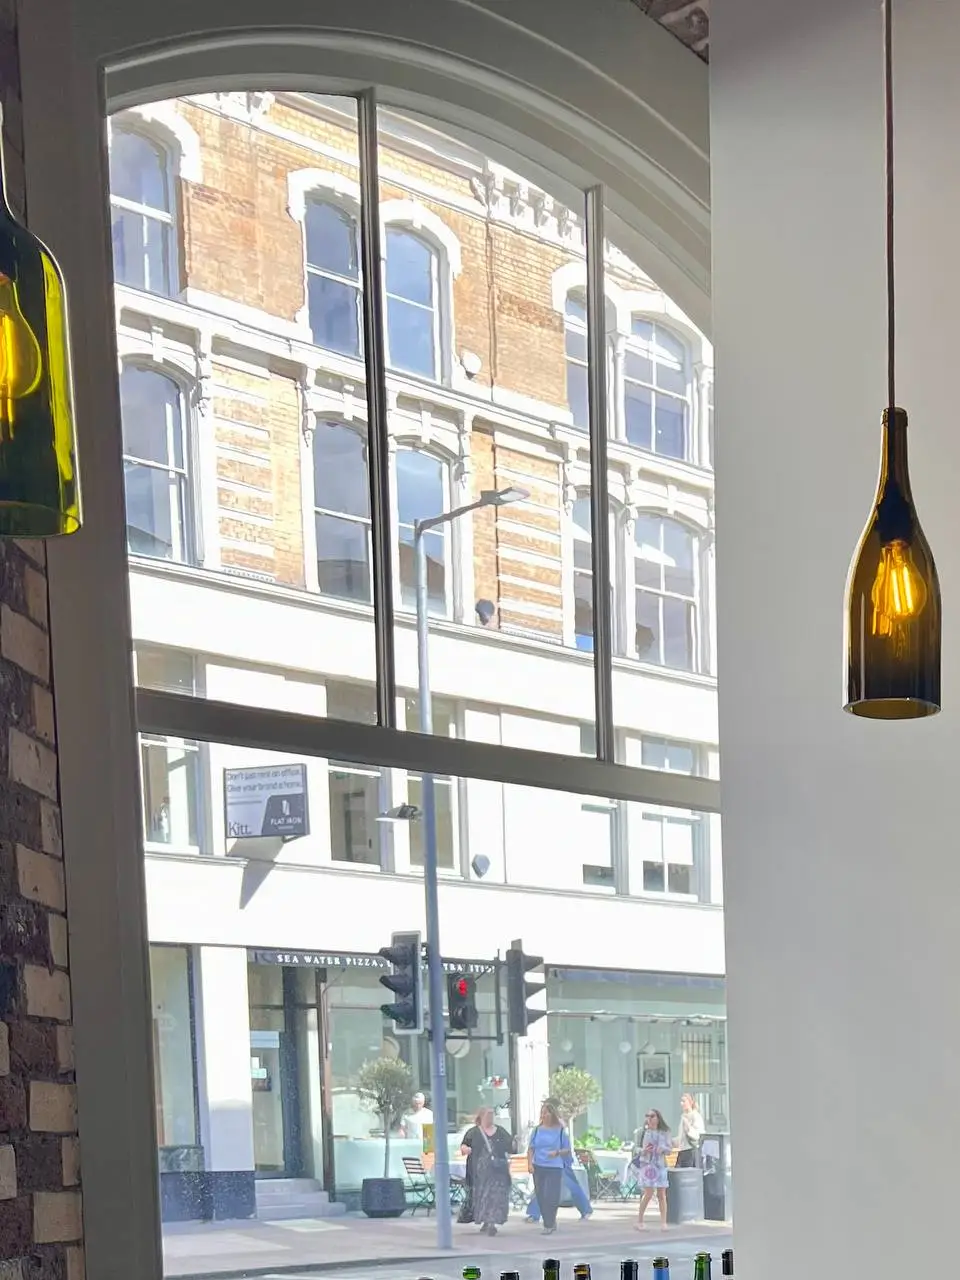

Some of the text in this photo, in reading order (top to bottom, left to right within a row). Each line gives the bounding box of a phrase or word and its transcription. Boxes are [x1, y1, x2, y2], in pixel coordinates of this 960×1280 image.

[270, 818, 285, 826] FLAT
[277, 953, 299, 964] SEA
[303, 955, 341, 965] WATER
[345, 957, 384, 968] PIZZA,
